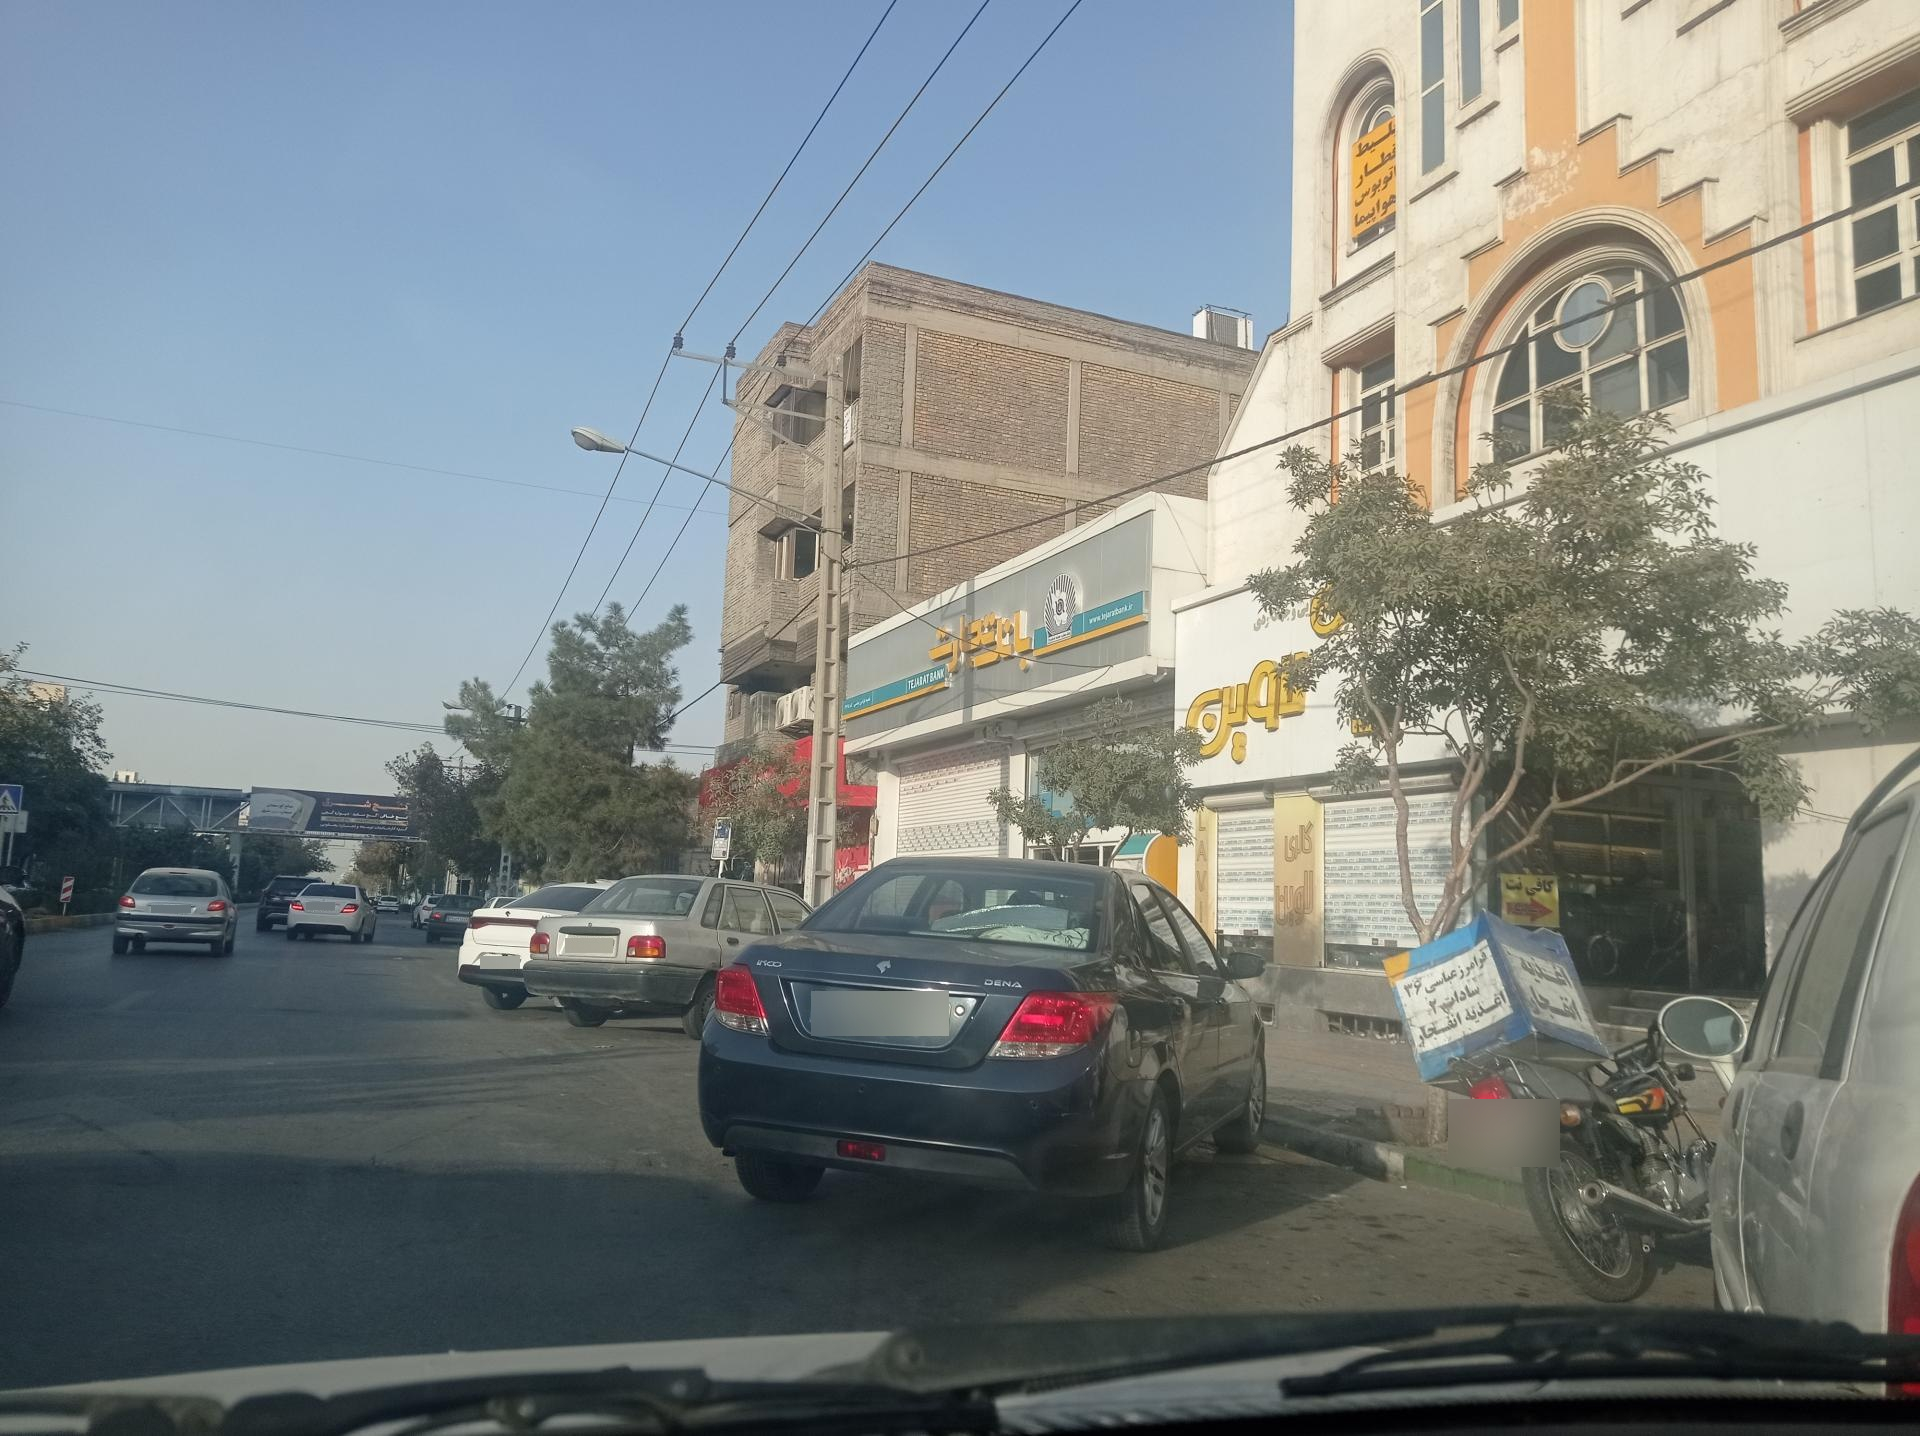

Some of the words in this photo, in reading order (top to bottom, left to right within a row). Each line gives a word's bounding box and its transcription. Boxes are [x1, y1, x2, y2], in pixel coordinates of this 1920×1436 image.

[907, 673, 929, 690] TEJARAT
[930, 667, 945, 683] BANK
[1505, 876, 1523, 890] نت
[1525, 876, 1554, 896] کافی
[983, 978, 1023, 989] DENA
[1425, 970, 1457, 994] عباسی
